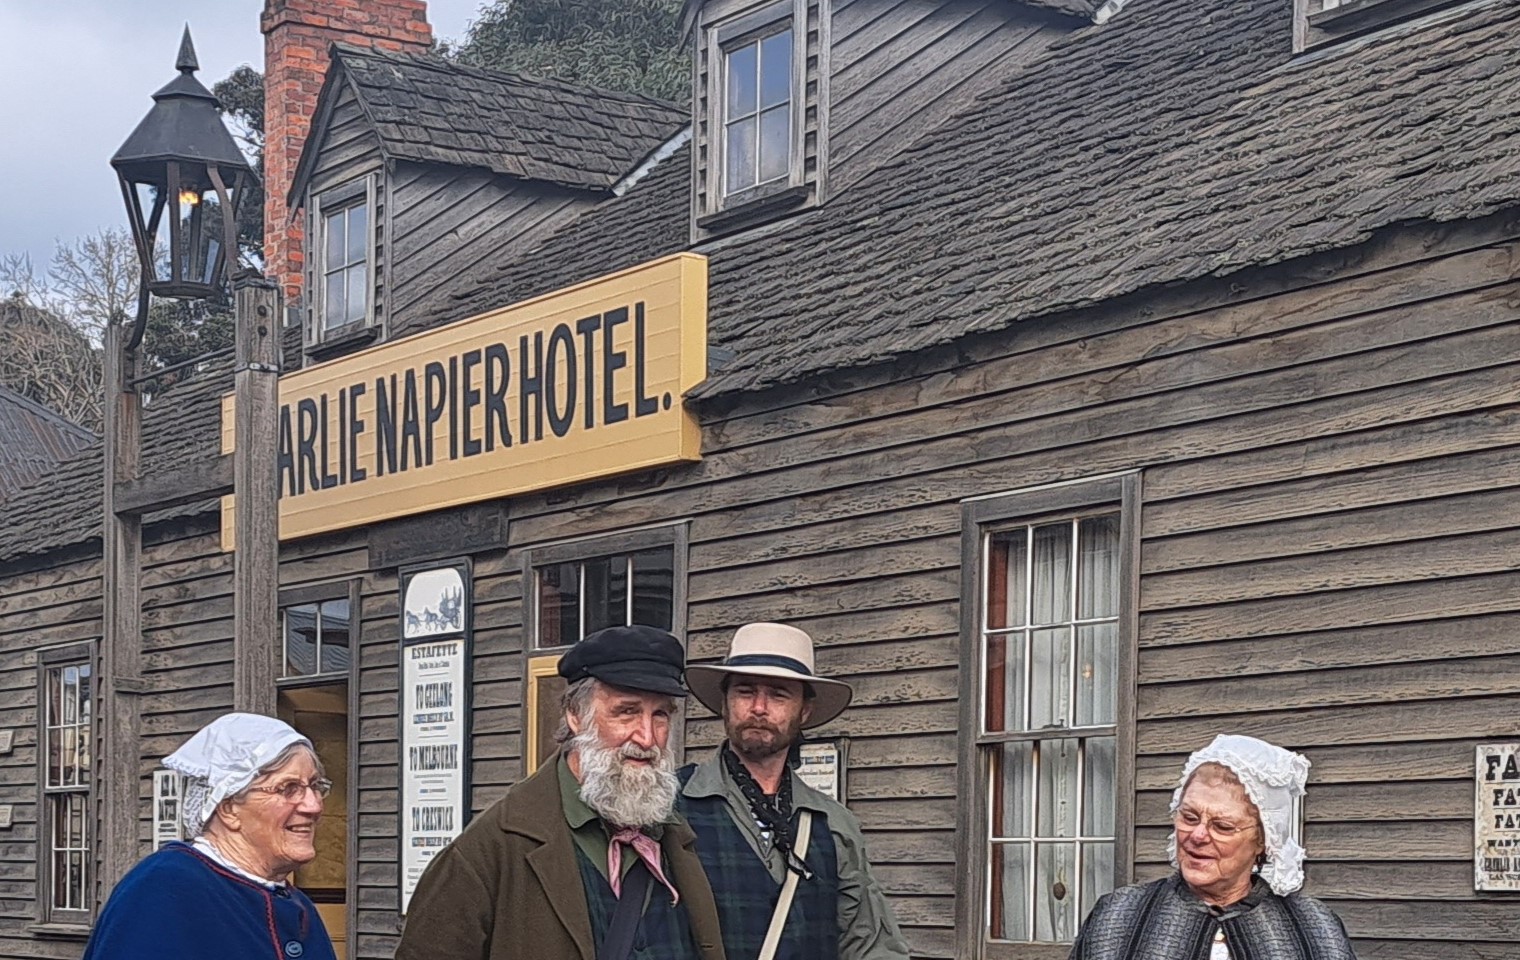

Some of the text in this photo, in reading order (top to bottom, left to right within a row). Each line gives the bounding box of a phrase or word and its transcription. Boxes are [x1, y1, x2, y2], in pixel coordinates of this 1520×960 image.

[277, 301, 672, 498] ARLIE NAPIER HOTEL.
[411, 643, 458, 660] ESTAFETTE
[415, 684, 424, 710] TO
[409, 744, 458, 771] TO MELBOURNE
[412, 806, 454, 832] TO CRESWICK
